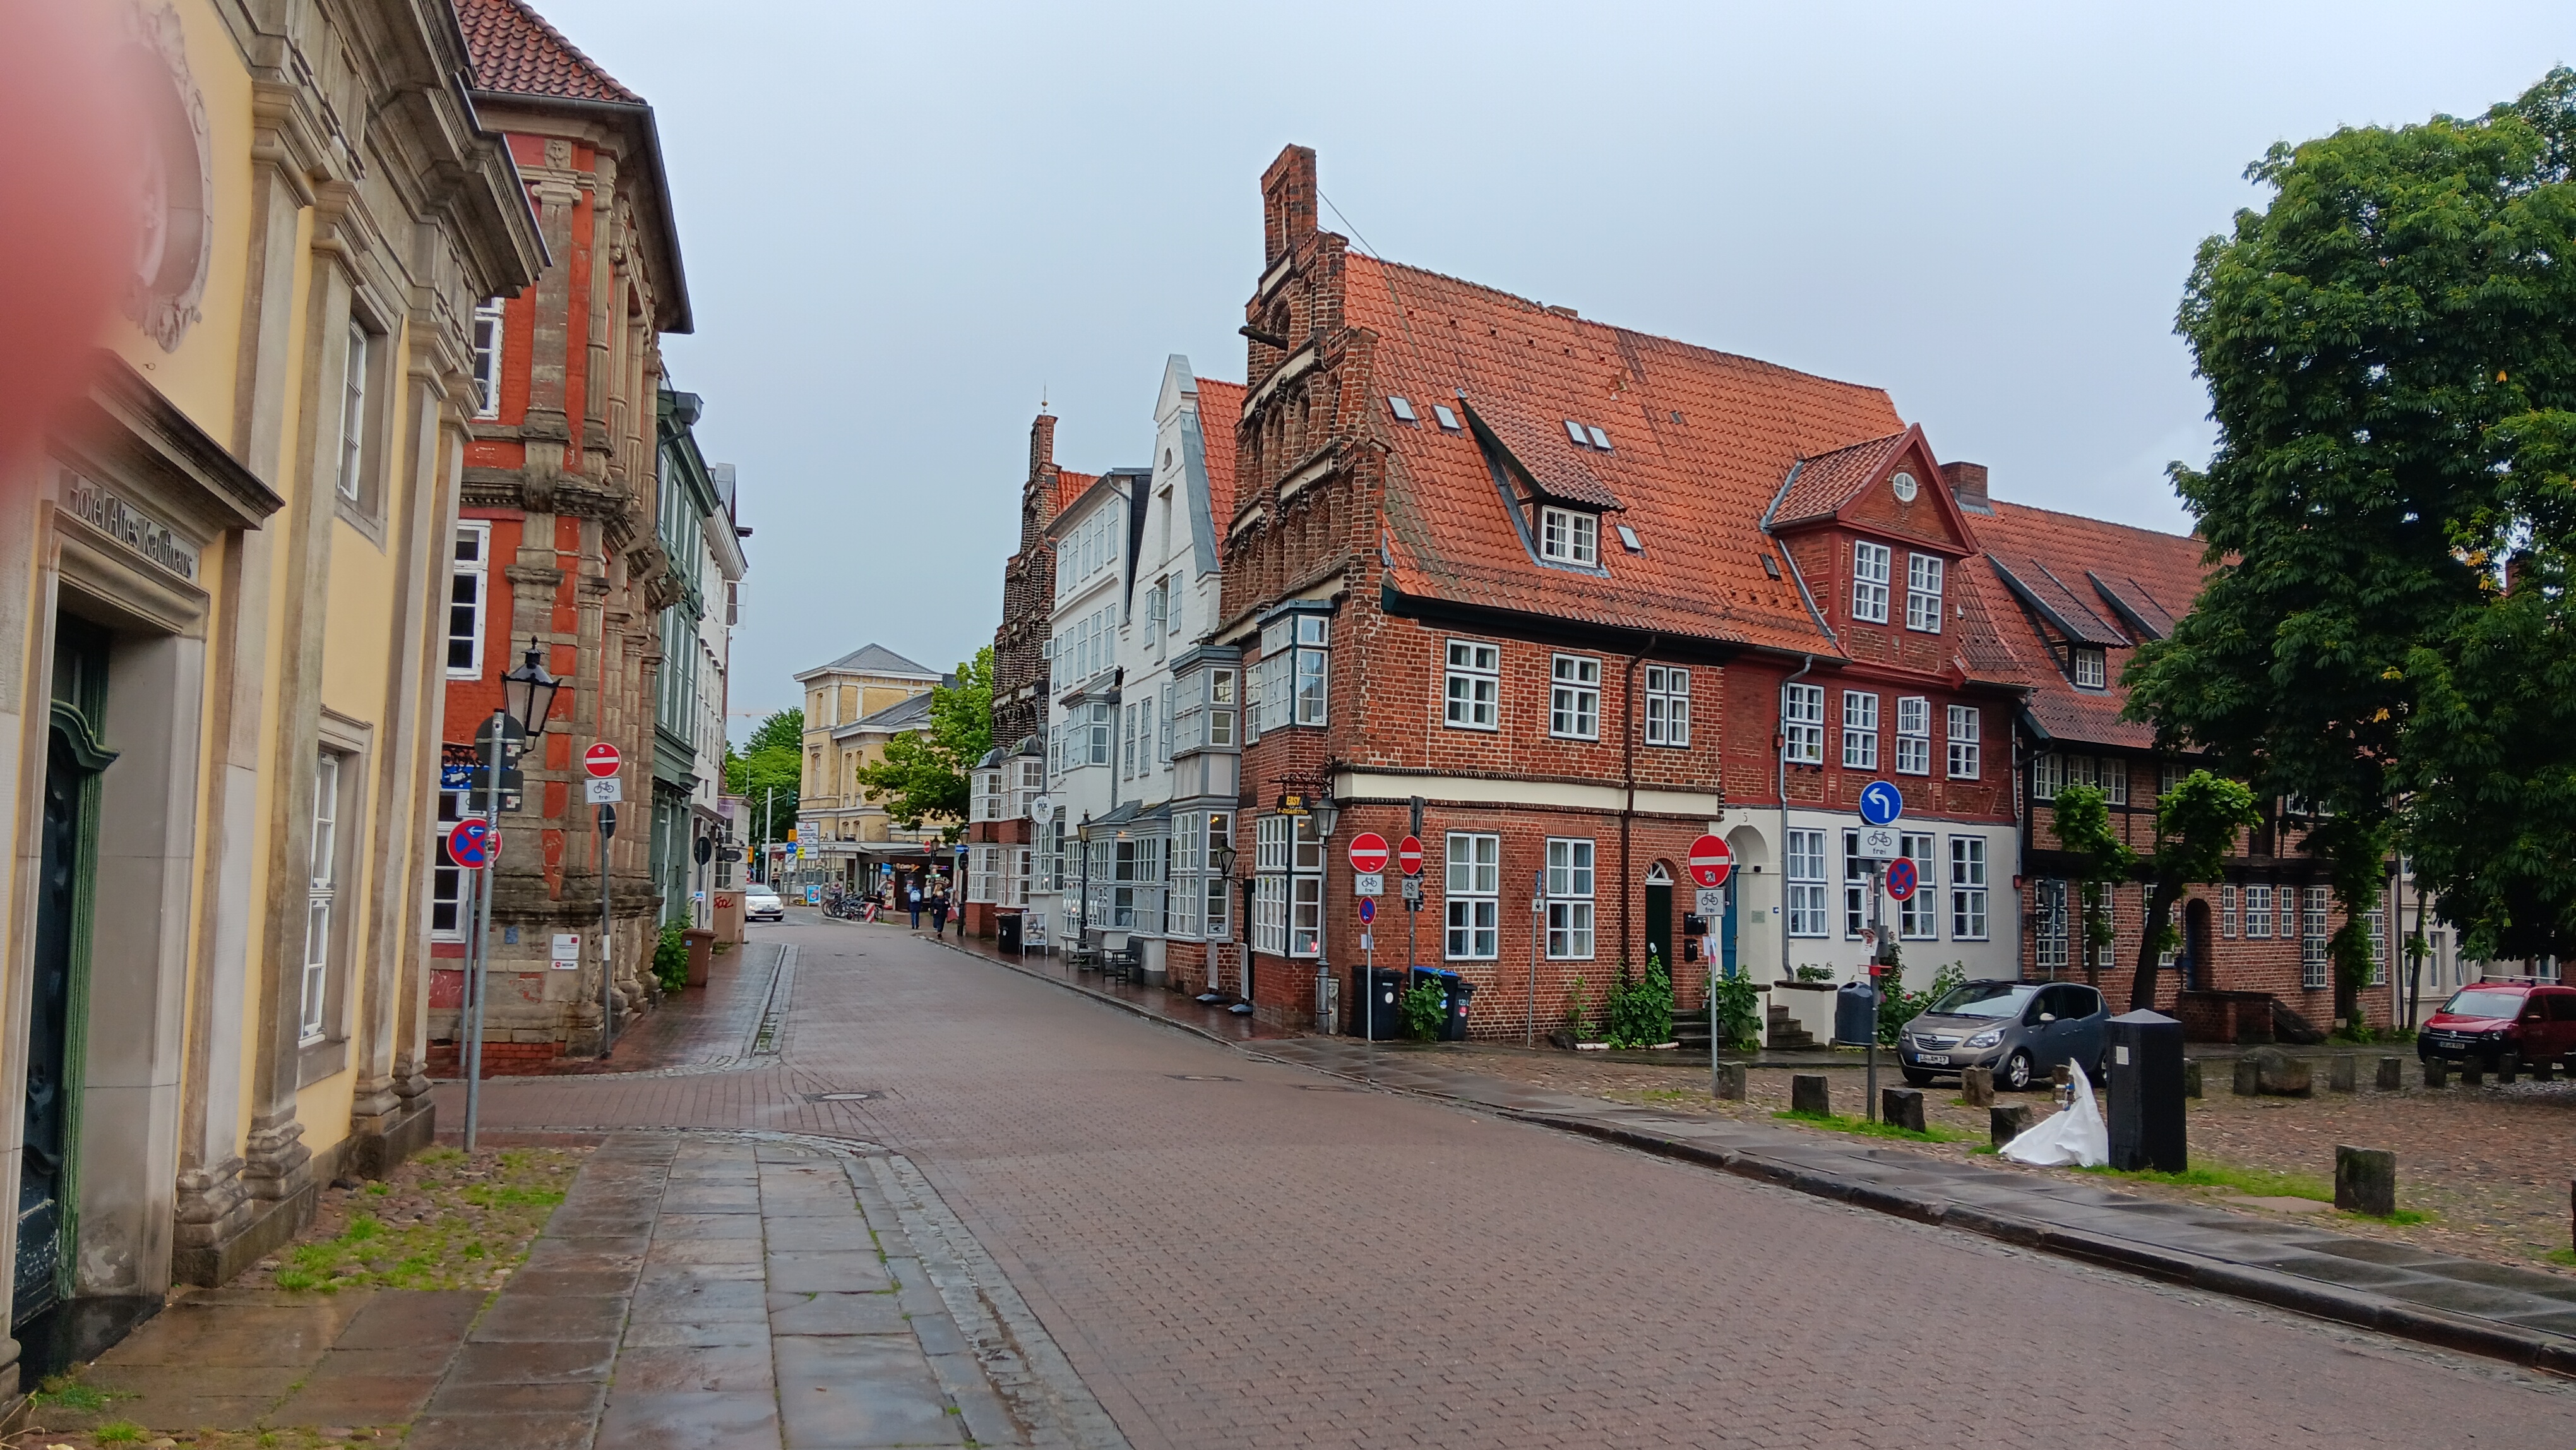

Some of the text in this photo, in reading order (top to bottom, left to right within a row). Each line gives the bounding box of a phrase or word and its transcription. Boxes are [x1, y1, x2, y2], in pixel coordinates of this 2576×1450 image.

[109, 496, 140, 549] Altes
[143, 518, 192, 579] Kaufhaus
[1286, 796, 1301, 806] EASY
[1743, 812, 1748, 822] 5
